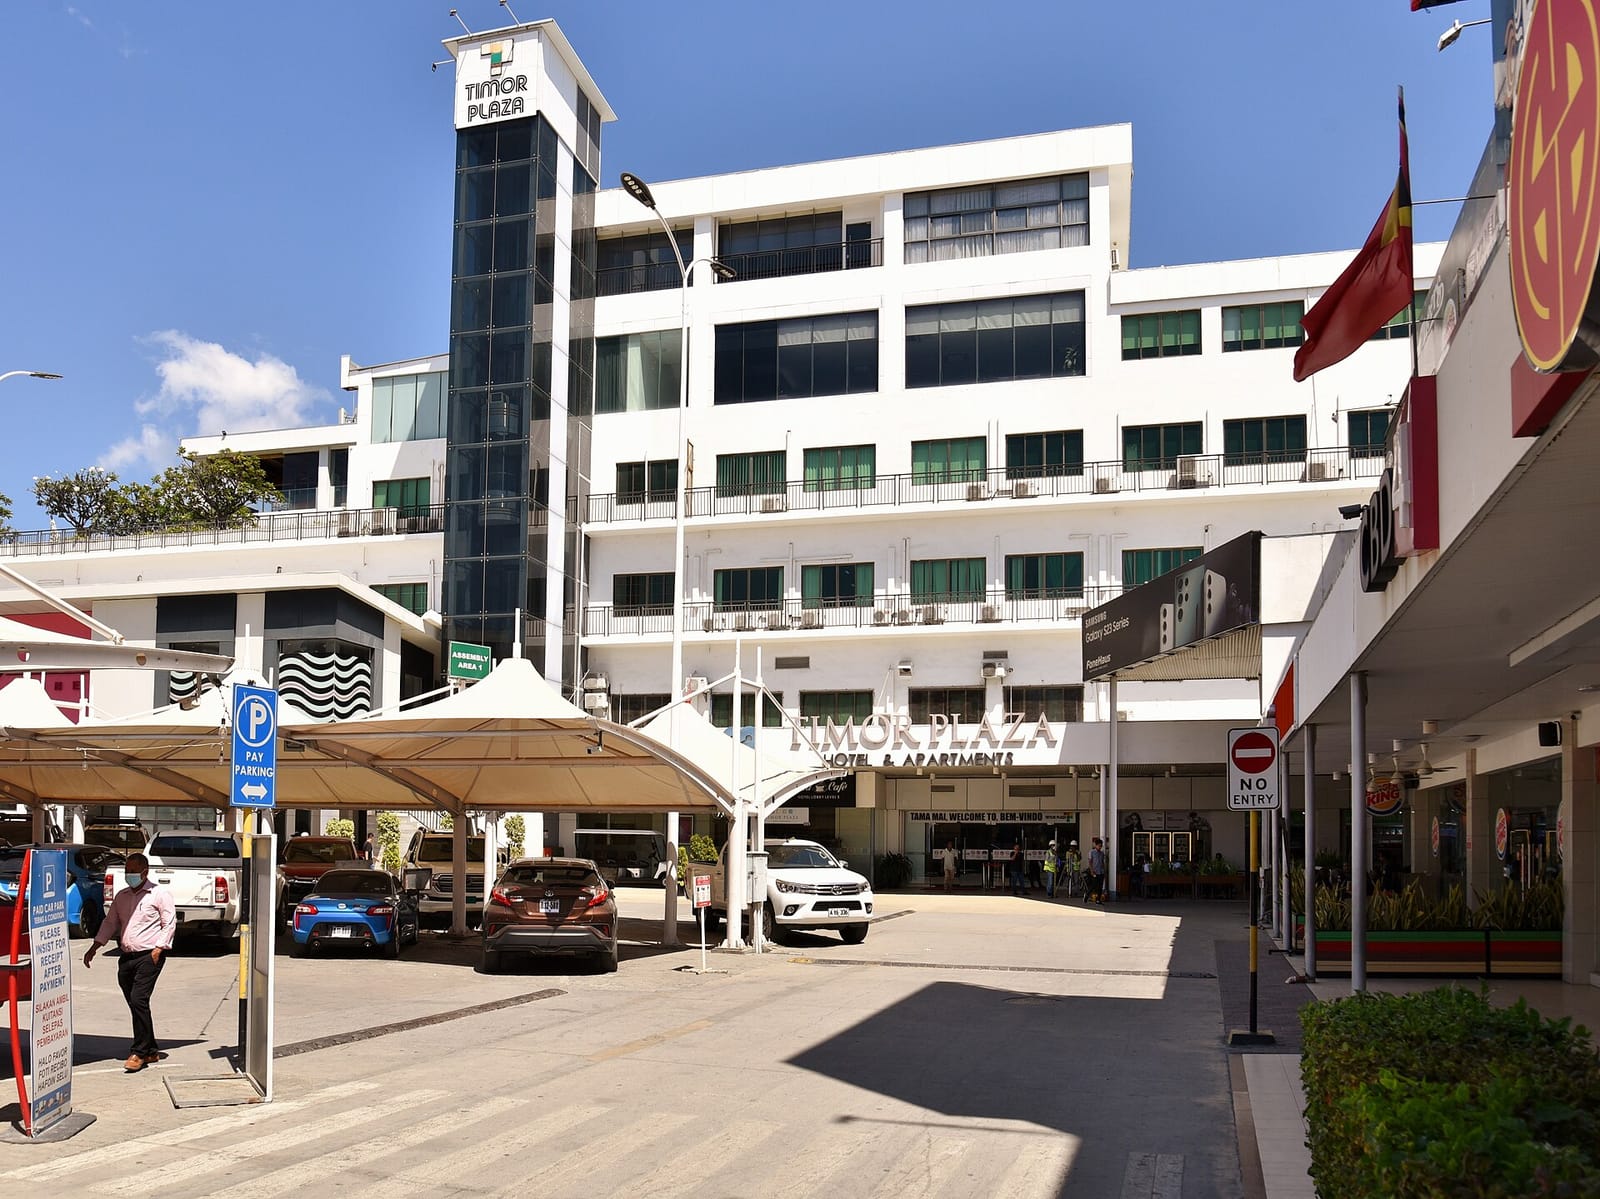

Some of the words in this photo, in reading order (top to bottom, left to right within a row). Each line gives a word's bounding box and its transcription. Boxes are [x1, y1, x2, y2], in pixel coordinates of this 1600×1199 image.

[465, 75, 528, 101] TIMOR
[467, 96, 524, 122] PLAZA
[1085, 611, 1107, 629] SAMSUNG
[1086, 629, 1103, 643] Galaxy
[1103, 623, 1113, 636] S23
[1113, 616, 1129, 632] Series
[452, 651, 489, 662] ASSEMBLY
[458, 662, 477, 670] AREA
[249, 702, 268, 740] P
[790, 713, 921, 747] TIMOR
[928, 711, 1057, 746] PLAZA
[246, 751, 264, 762] PAY
[822, 752, 873, 767] HOTEL
[882, 754, 895, 767] &
[903, 752, 1014, 767] APARTMENTS
[235, 764, 274, 778] PARKING
[1240, 777, 1267, 790] NO
[1233, 793, 1274, 806] ENTRY
[1367, 790, 1400, 806] KING
[911, 812, 931, 821] TAMA
[949, 812, 985, 821] WELCOME
[1000, 812, 1043, 821] BEM-VINDO
[33, 904, 44, 915] PAID
[44, 902, 54, 913] CAR
[54, 900, 64, 910] PARK
[40, 927, 61, 941] PLEASE
[36, 941, 54, 955] INSIST
[55, 938, 66, 949] FOR
[40, 951, 63, 967] RECEIPT
[43, 965, 61, 979] AFTER
[40, 976, 65, 993] PAYMENT
[35, 998, 55, 1013] SILAKAN
[42, 1019, 64, 1034] SELEPAS
[36, 1029, 69, 1048] PEMBAYARAN
[38, 1054, 52, 1068] HALO
[53, 1047, 68, 1060] FAVOR
